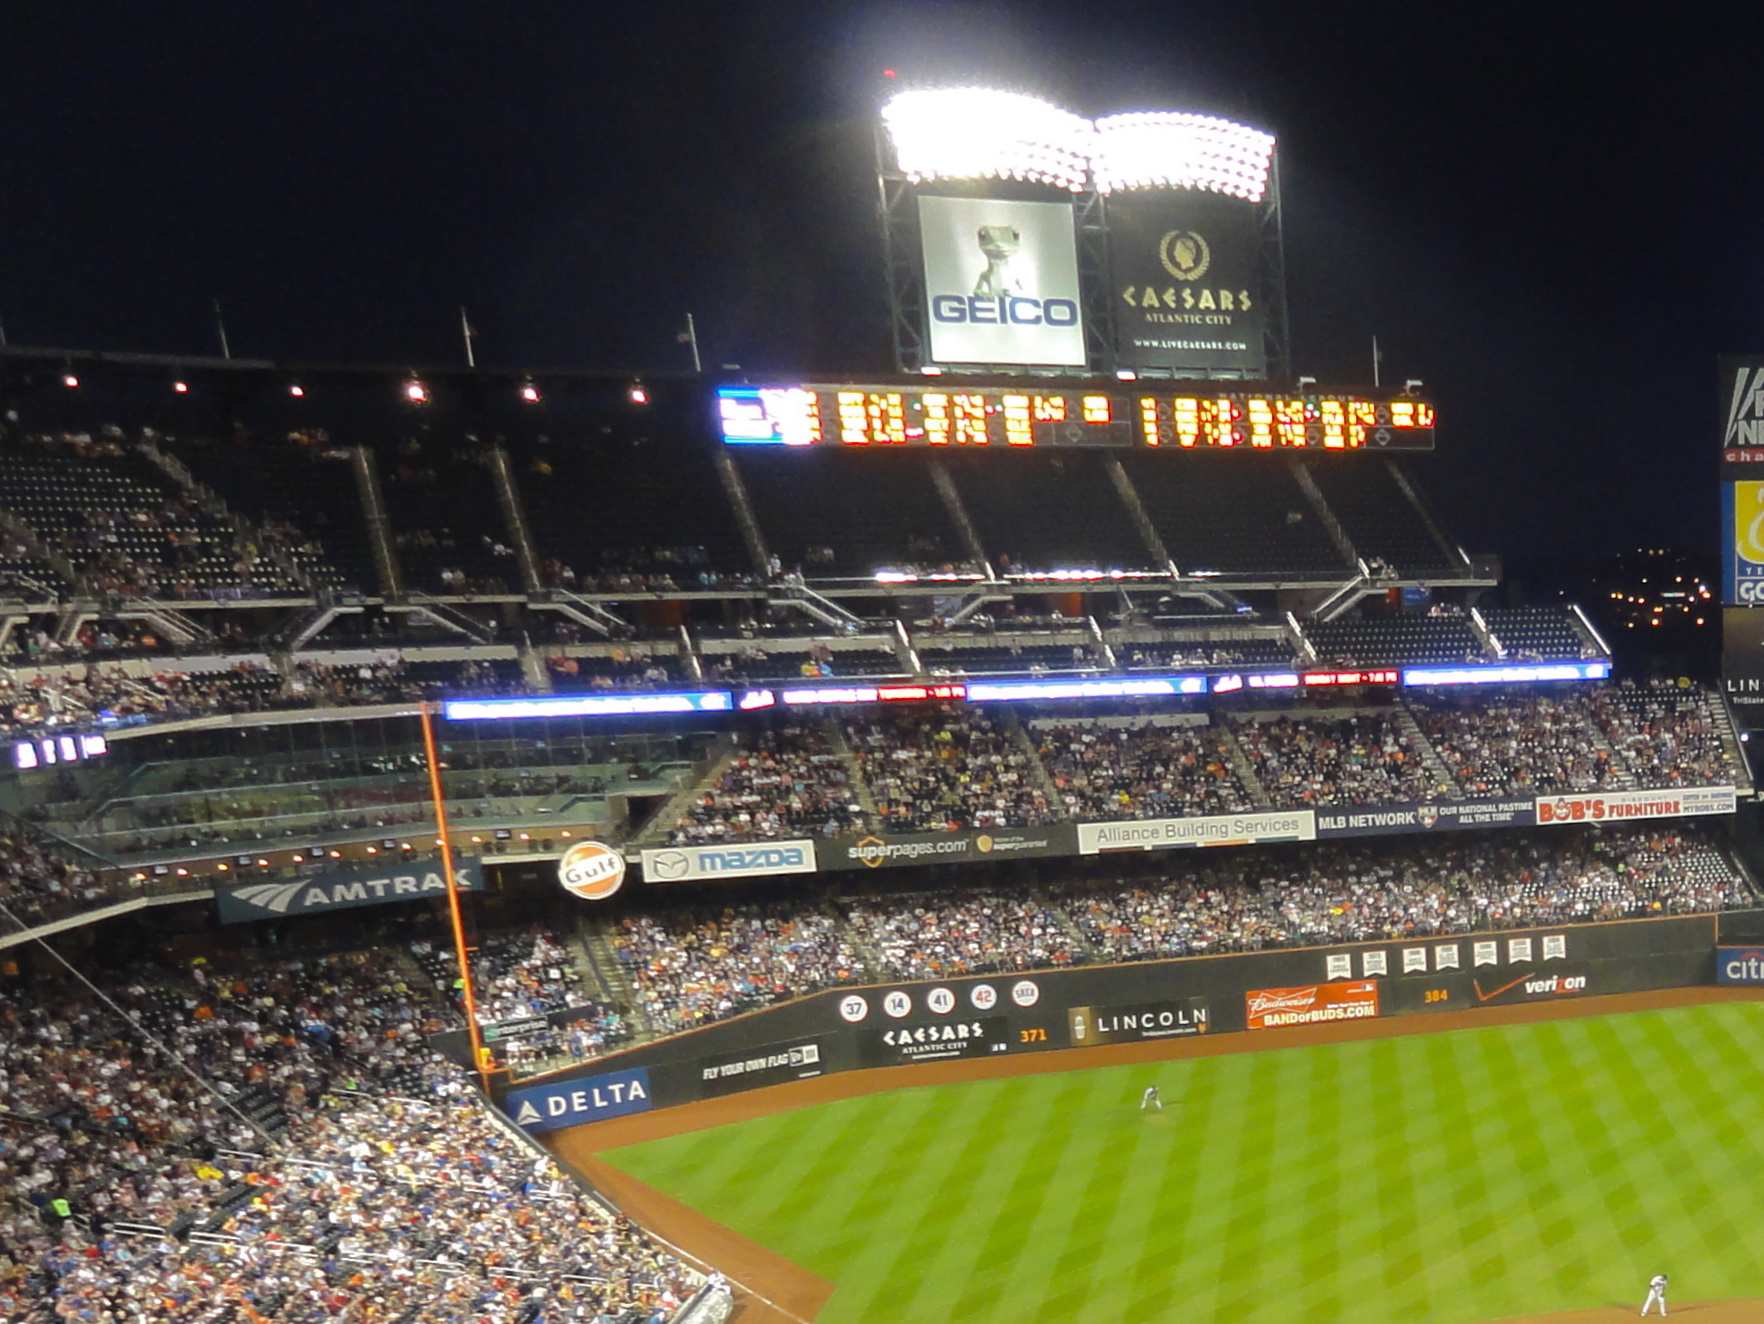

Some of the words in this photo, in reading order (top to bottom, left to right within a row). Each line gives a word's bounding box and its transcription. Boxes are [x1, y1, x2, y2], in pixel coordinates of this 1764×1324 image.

[1122, 285, 1252, 311] CAESARS
[932, 297, 1078, 326] GEICO
[1145, 313, 1200, 324] ATLANTIC
[1203, 314, 1232, 325] CITY
[1440, 806, 1457, 815] OUR
[1459, 804, 1496, 813] NATIONAL
[1499, 802, 1533, 811] PASTIME
[1539, 799, 1605, 822] BOB'S
[1609, 801, 1680, 817] FURNITURE
[1319, 816, 1346, 829] MLB
[1349, 812, 1415, 827] NETWORK
[1459, 815, 1473, 823] ALL
[1475, 814, 1490, 822] THE
[1097, 828, 1159, 842] Alliance
[1166, 822, 1228, 838] Building
[1234, 818, 1299, 834] Services
[849, 840, 966, 858] superpages.com
[698, 848, 804, 871] mazda
[565, 857, 618, 884] Gulf
[302, 869, 472, 907] AMTRAK
[1525, 975, 1586, 995] verizon
[890, 998, 905, 1011] 14
[933, 994, 949, 1006] 41
[975, 990, 993, 1003] 42
[1424, 989, 1448, 1003] 384
[846, 1002, 863, 1016] 37
[1098, 1008, 1206, 1032] LINCOLN
[884, 1022, 983, 1046] CAESARS
[1020, 1028, 1047, 1043] 371
[902, 1043, 945, 1055] ATLANTIC
[948, 1041, 968, 1050] CITY
[703, 1067, 719, 1079] FLY
[720, 1062, 744, 1076] YOUR
[745, 1058, 767, 1072] OWN
[768, 1053, 789, 1067] FLAG
[548, 1080, 646, 1117] DELTA
